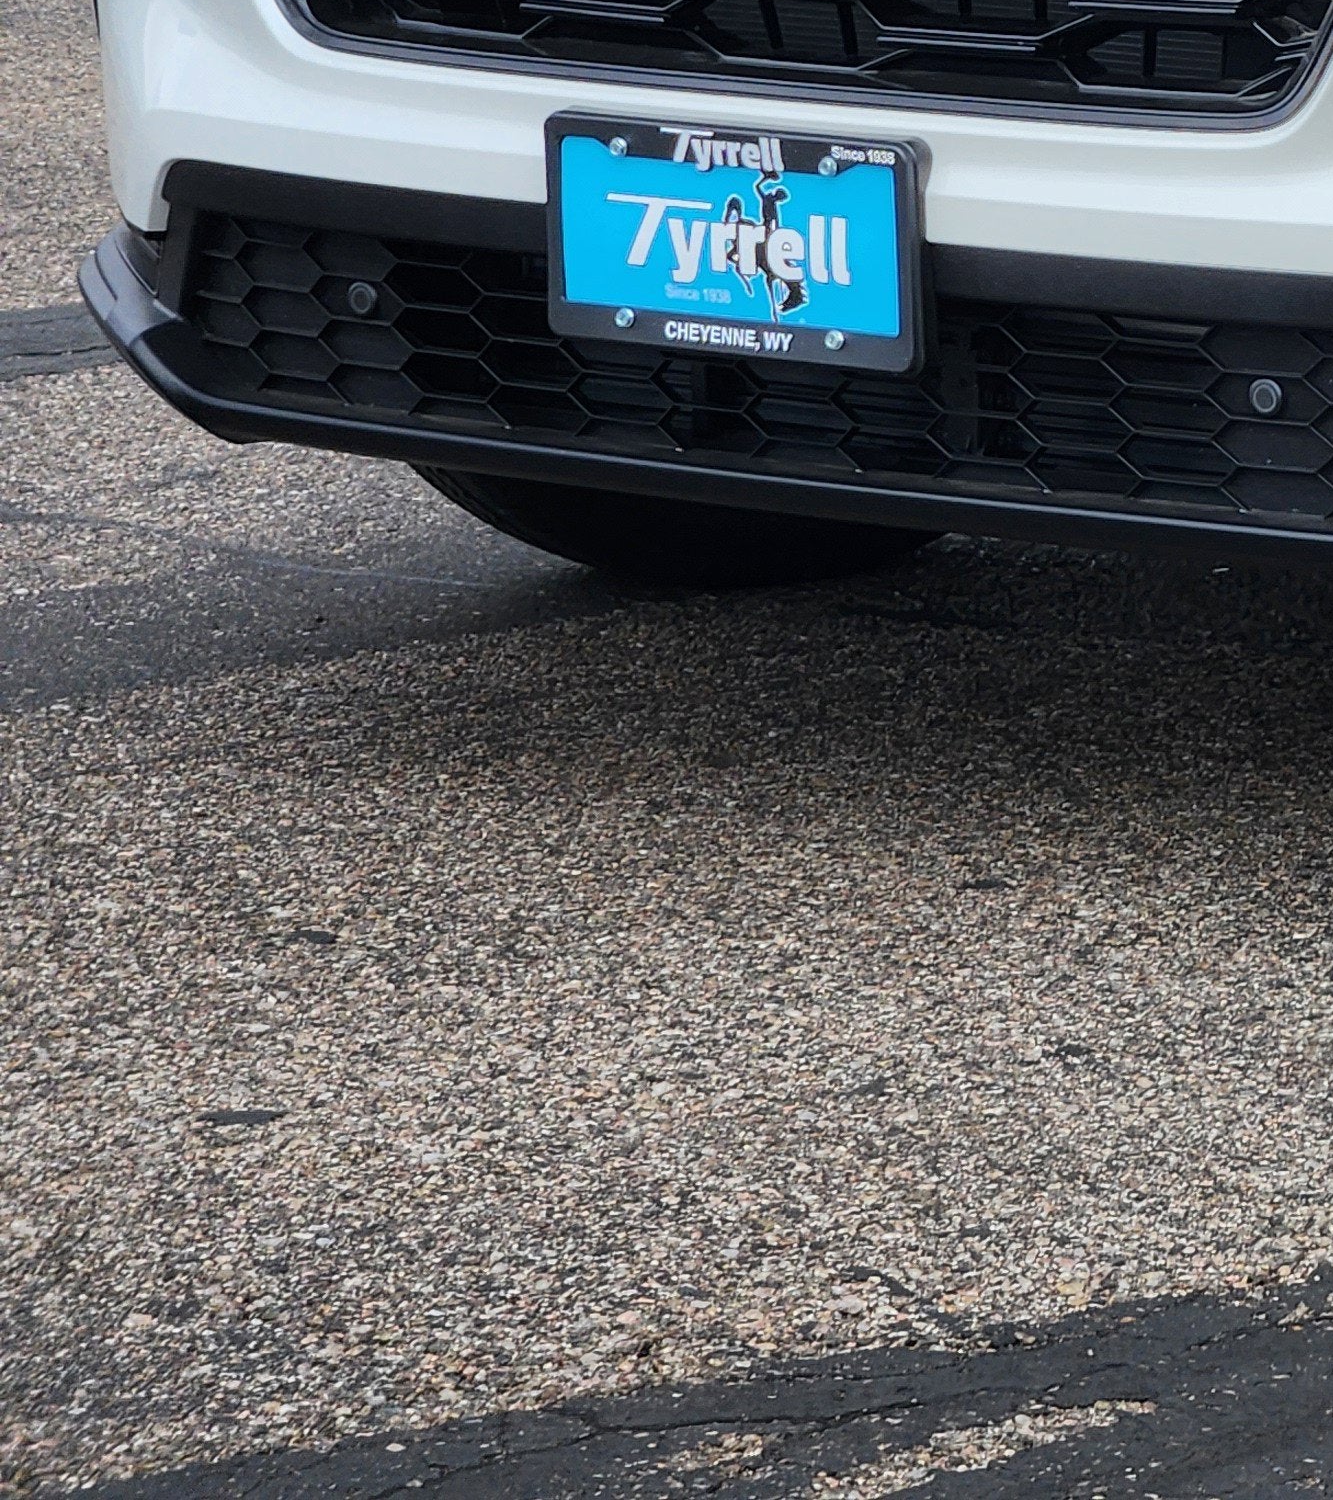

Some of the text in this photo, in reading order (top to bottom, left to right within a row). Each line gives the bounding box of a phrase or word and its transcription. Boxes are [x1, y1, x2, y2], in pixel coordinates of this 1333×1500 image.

[660, 127, 785, 172] Tyrrell
[605, 192, 852, 286] Tyrrell
[664, 320, 793, 352] CHEYENNE, WY
